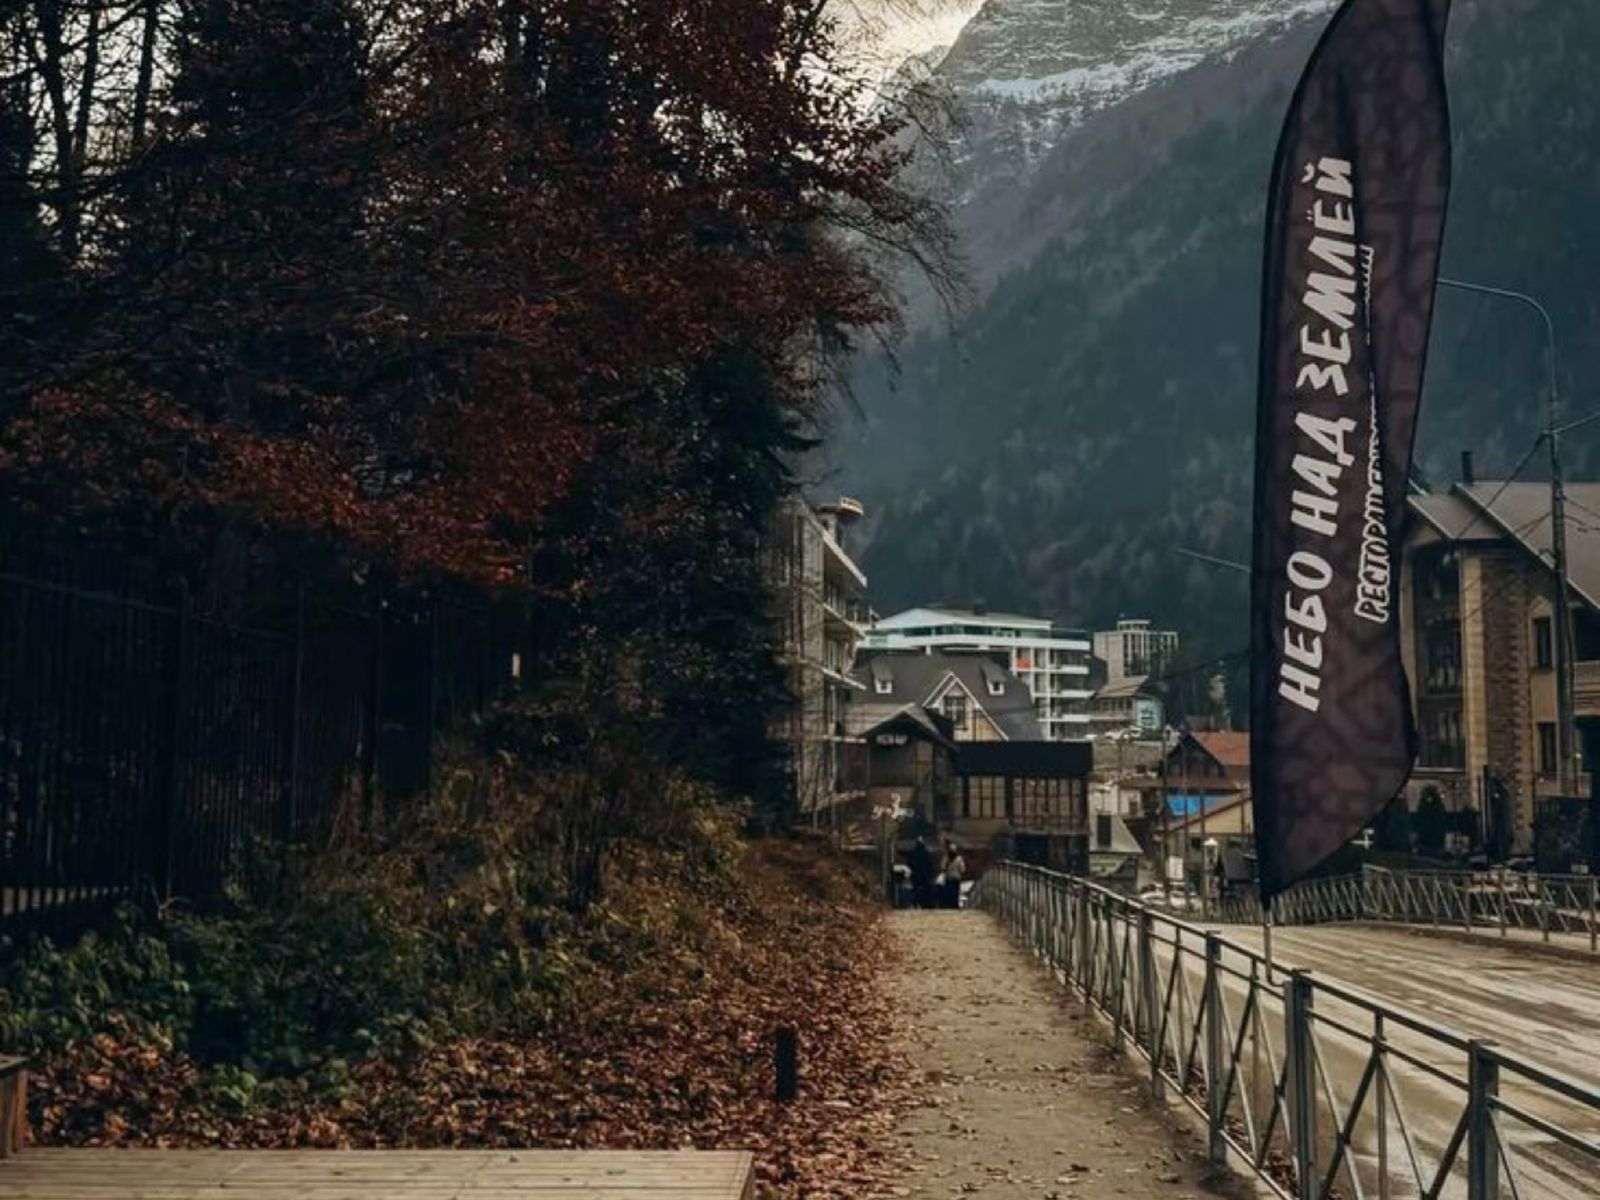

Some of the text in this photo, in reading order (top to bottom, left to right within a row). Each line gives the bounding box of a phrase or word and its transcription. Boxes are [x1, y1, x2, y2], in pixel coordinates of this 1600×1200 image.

[1278, 157, 1357, 712] НЕБО НАД ЗЕМЛЁЙ
